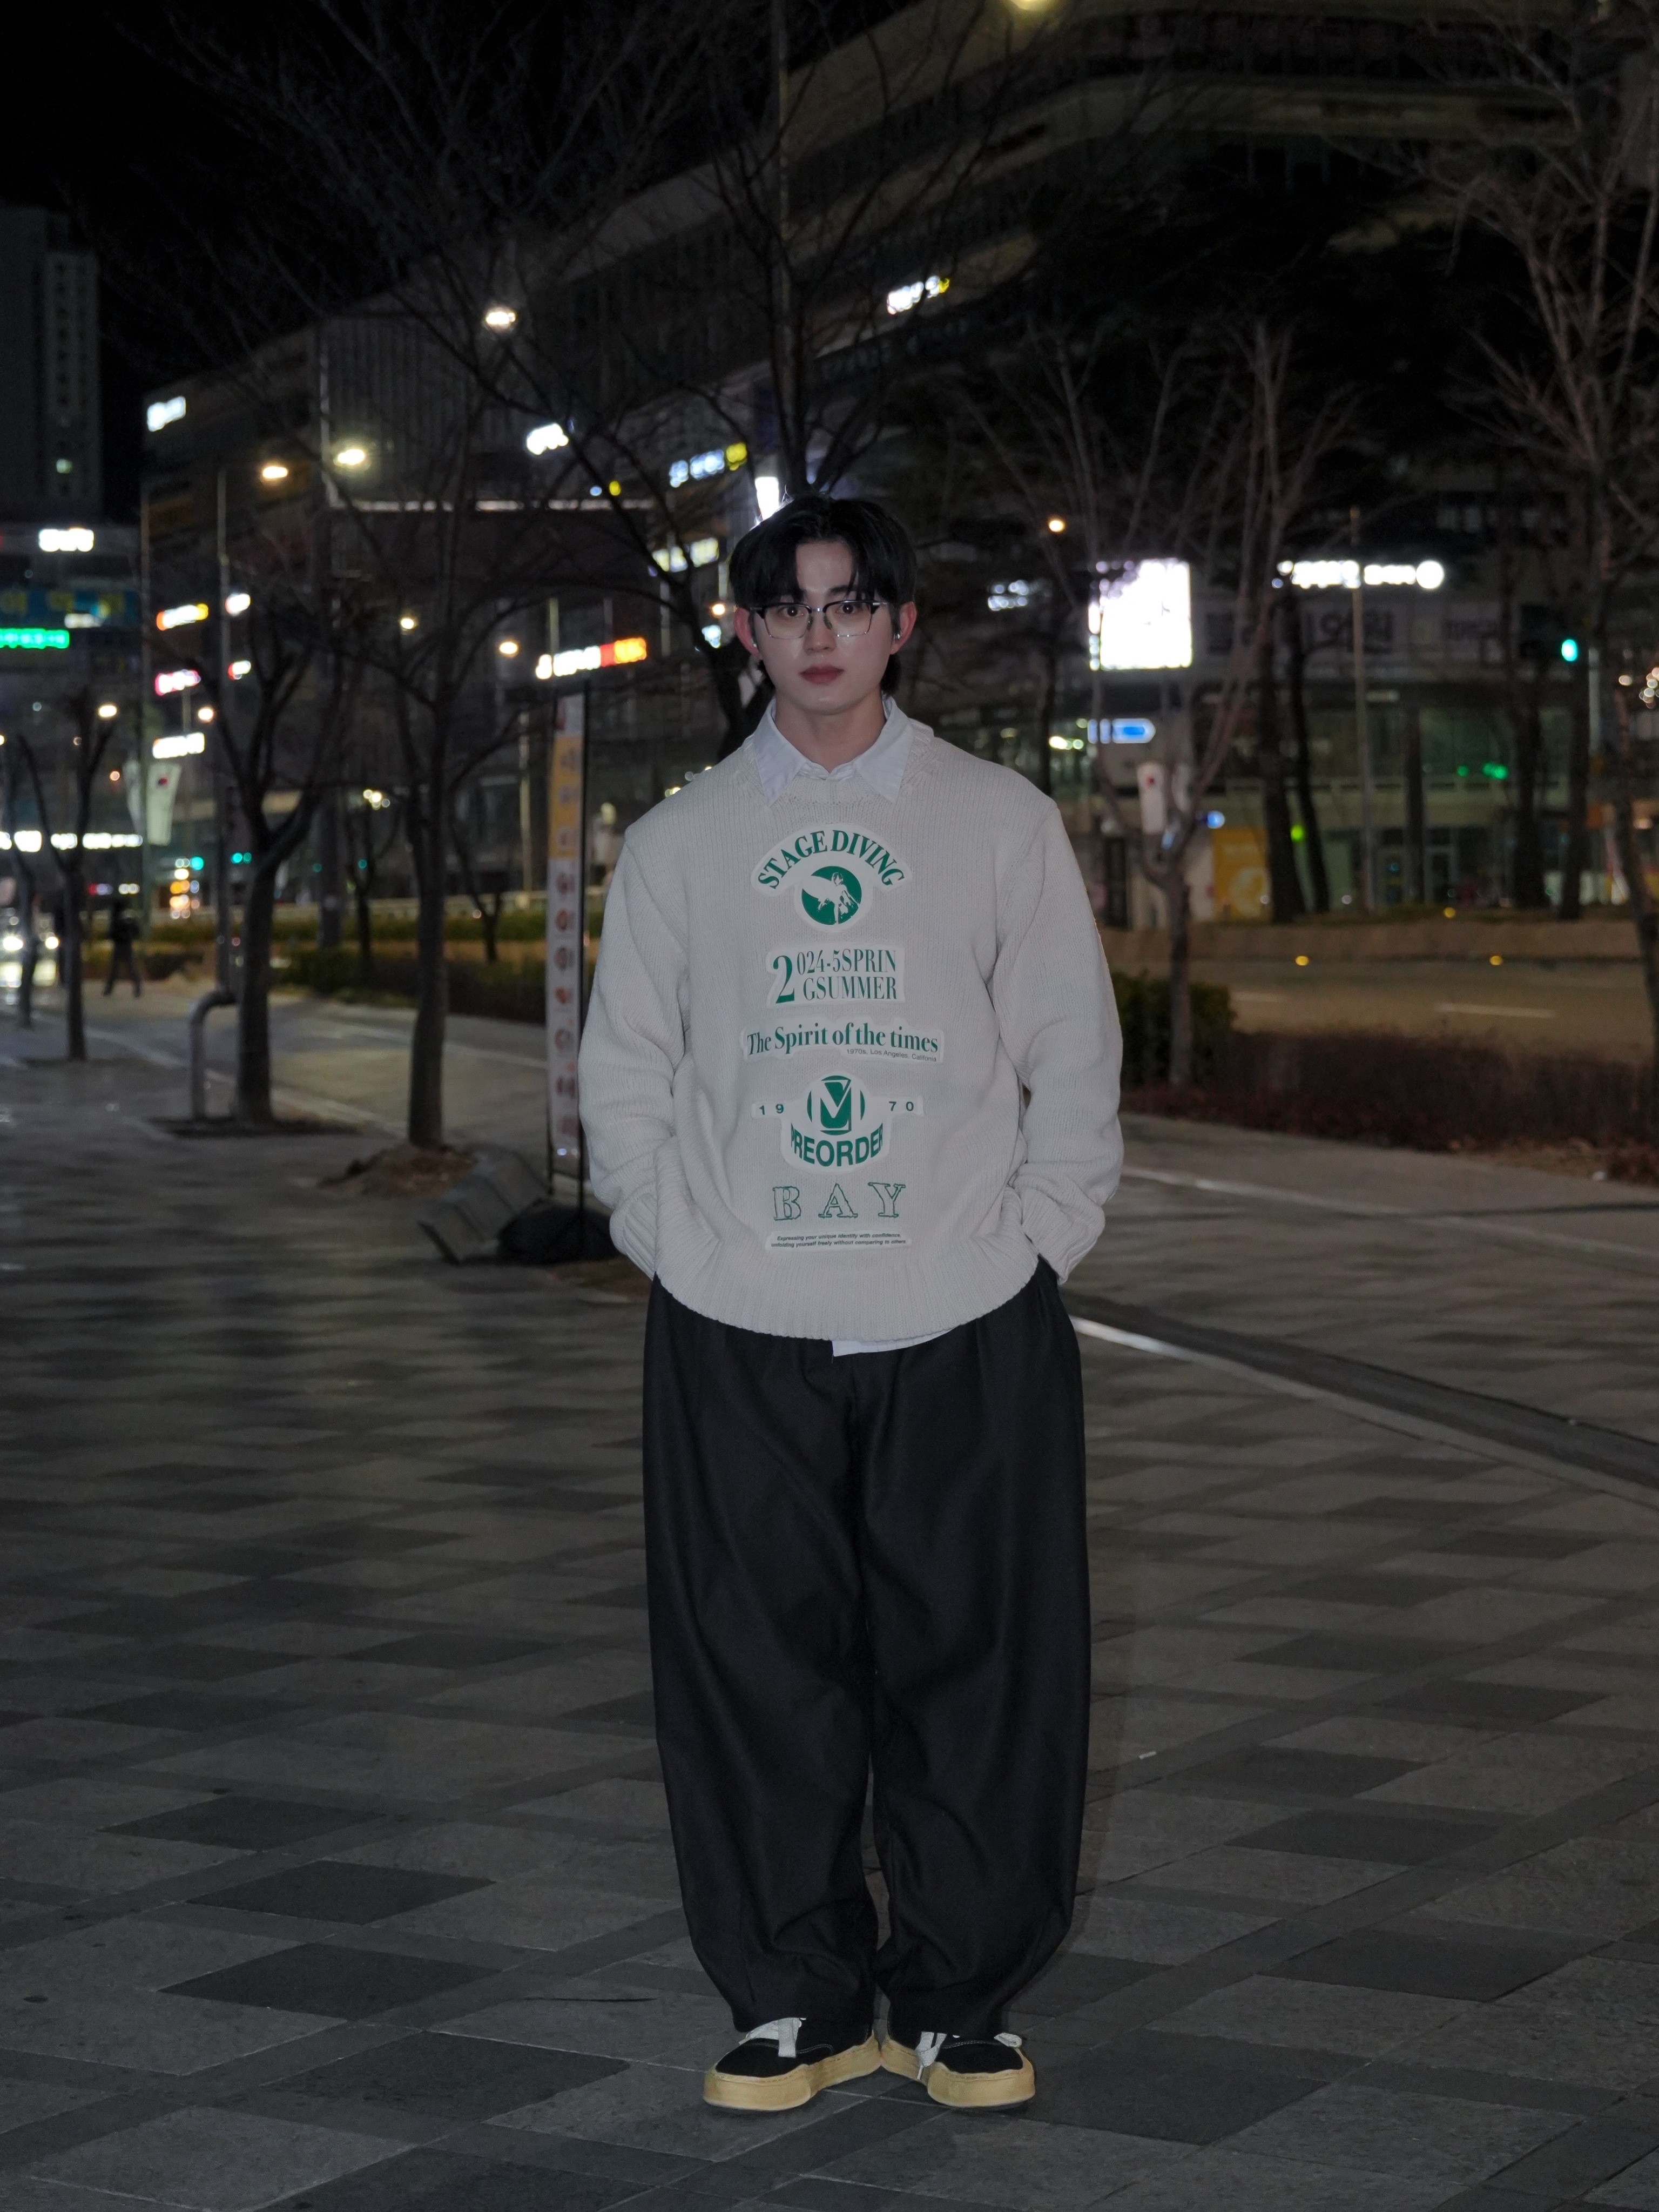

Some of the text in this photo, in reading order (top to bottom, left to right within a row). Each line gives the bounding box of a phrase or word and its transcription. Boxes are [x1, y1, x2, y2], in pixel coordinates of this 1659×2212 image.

[758, 829, 905, 889] STAGE DIVING
[802, 976, 898, 1000] GSUMMER
[747, 1022, 938, 1055] The Spirit of the times
[772, 1181, 906, 1221] BAY
